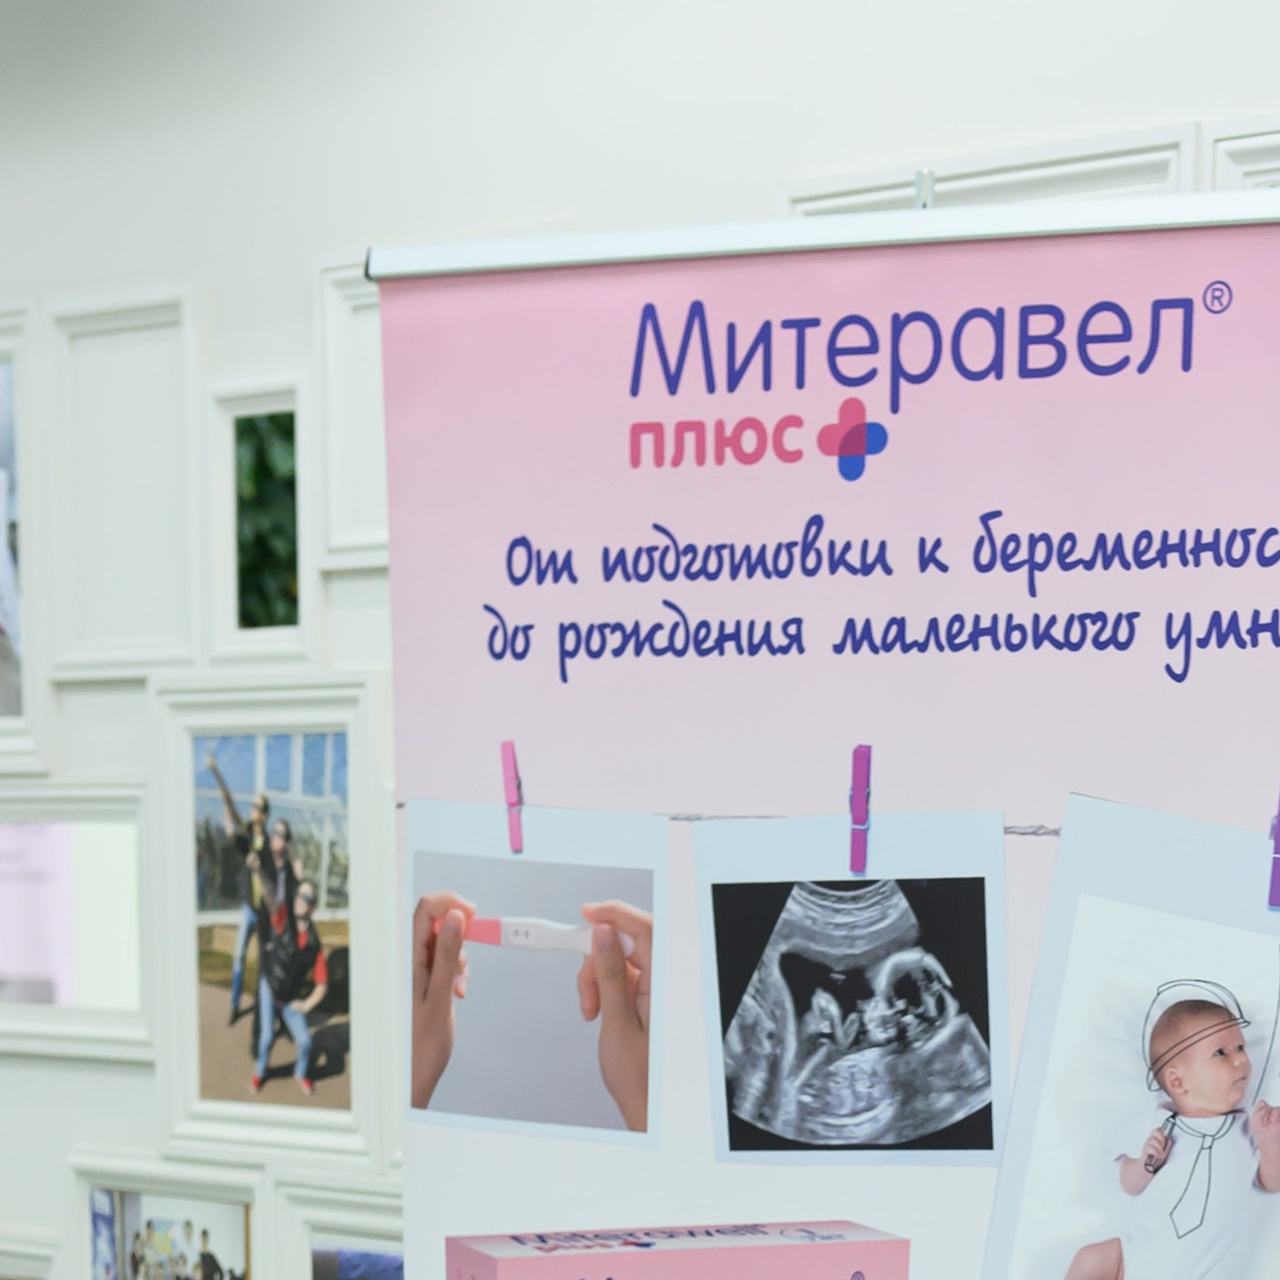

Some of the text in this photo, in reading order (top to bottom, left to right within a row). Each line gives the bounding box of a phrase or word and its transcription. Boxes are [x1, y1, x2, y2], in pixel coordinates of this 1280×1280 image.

[629, 413, 805, 469] плюс
[506, 535, 577, 586] От
[602, 514, 891, 584] подготовки
[917, 532, 948, 574] к
[484, 603, 534, 661] до
[558, 600, 805, 683] рождения
[832, 608, 1140, 656] маленького
